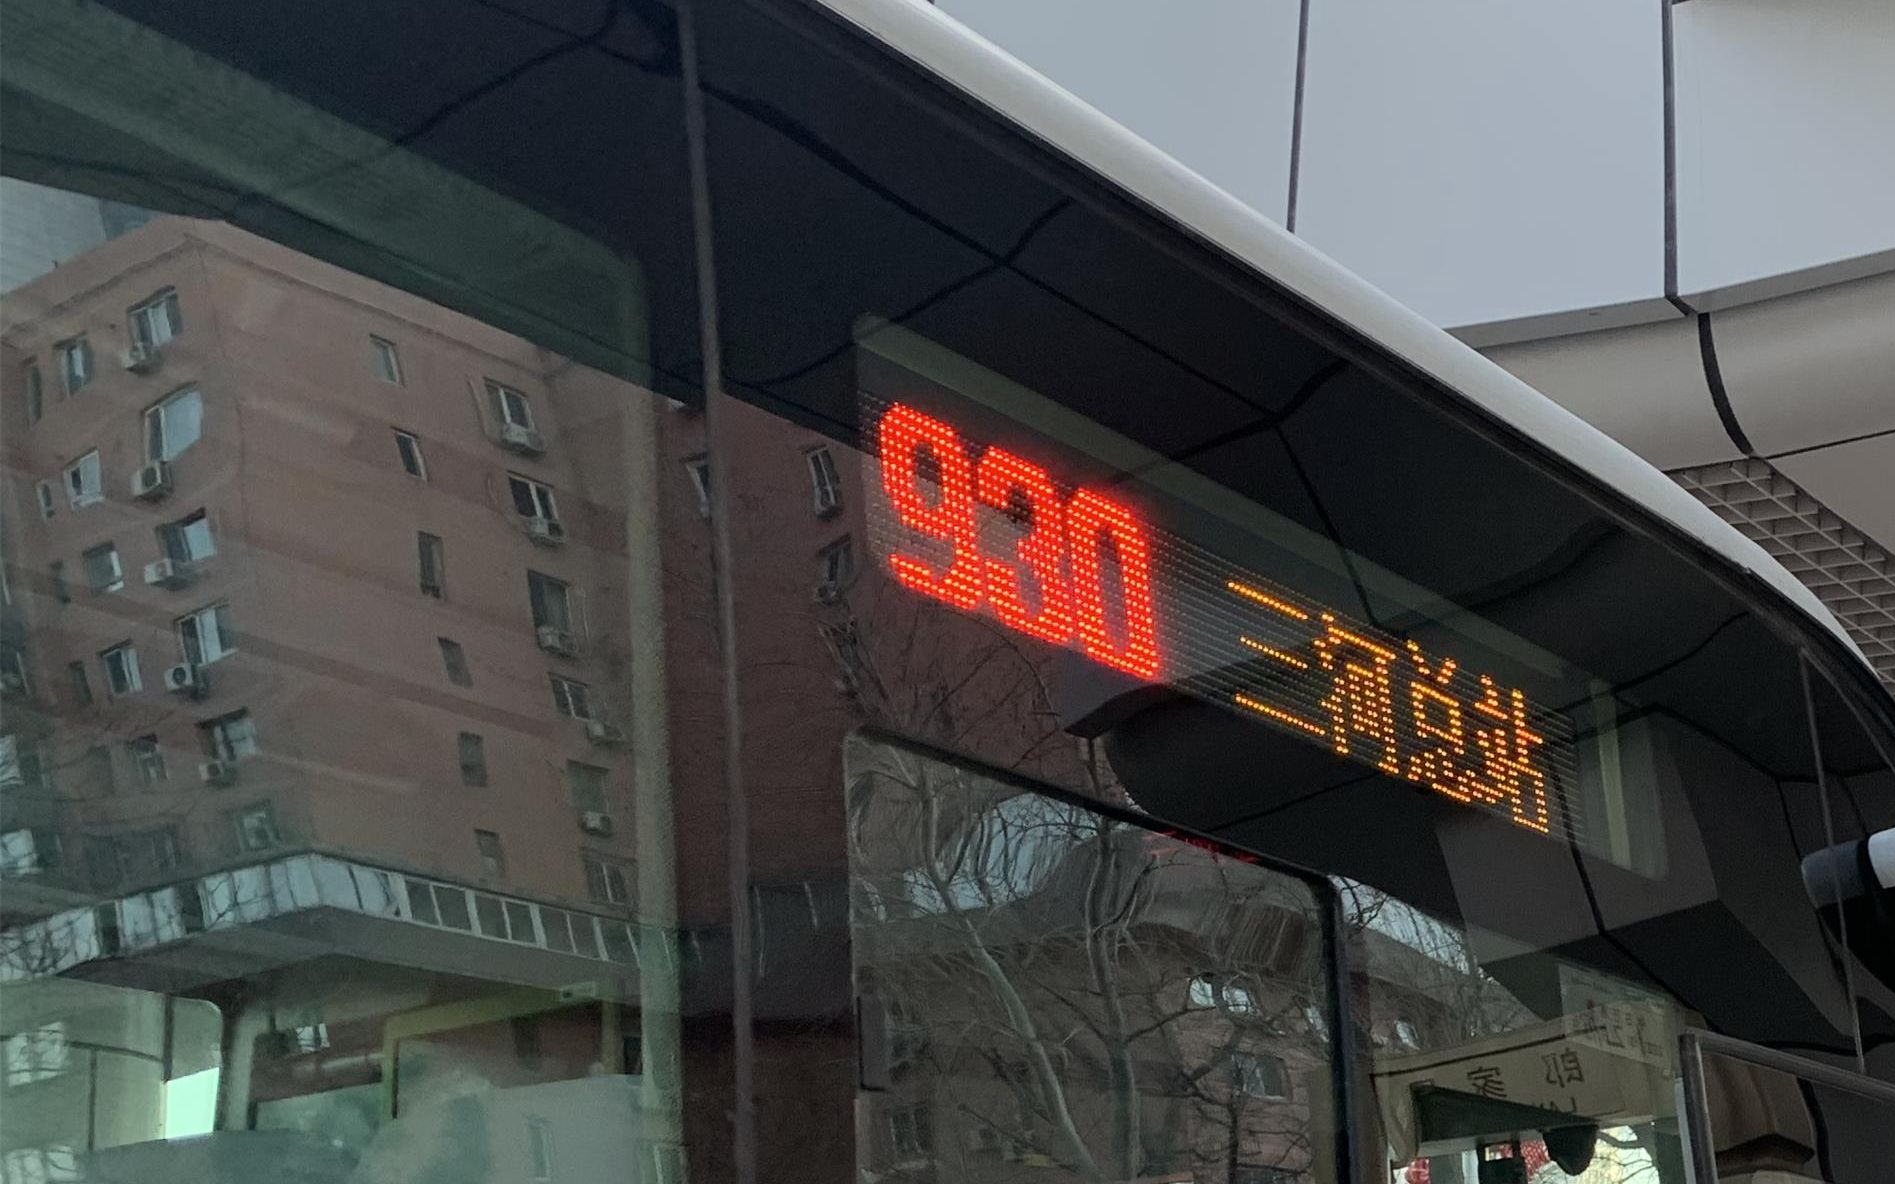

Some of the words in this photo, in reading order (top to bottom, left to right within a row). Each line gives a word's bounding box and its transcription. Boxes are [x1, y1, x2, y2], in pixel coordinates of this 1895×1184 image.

[879, 401, 1162, 680] 930
[1228, 581, 1550, 833] 三河总站
